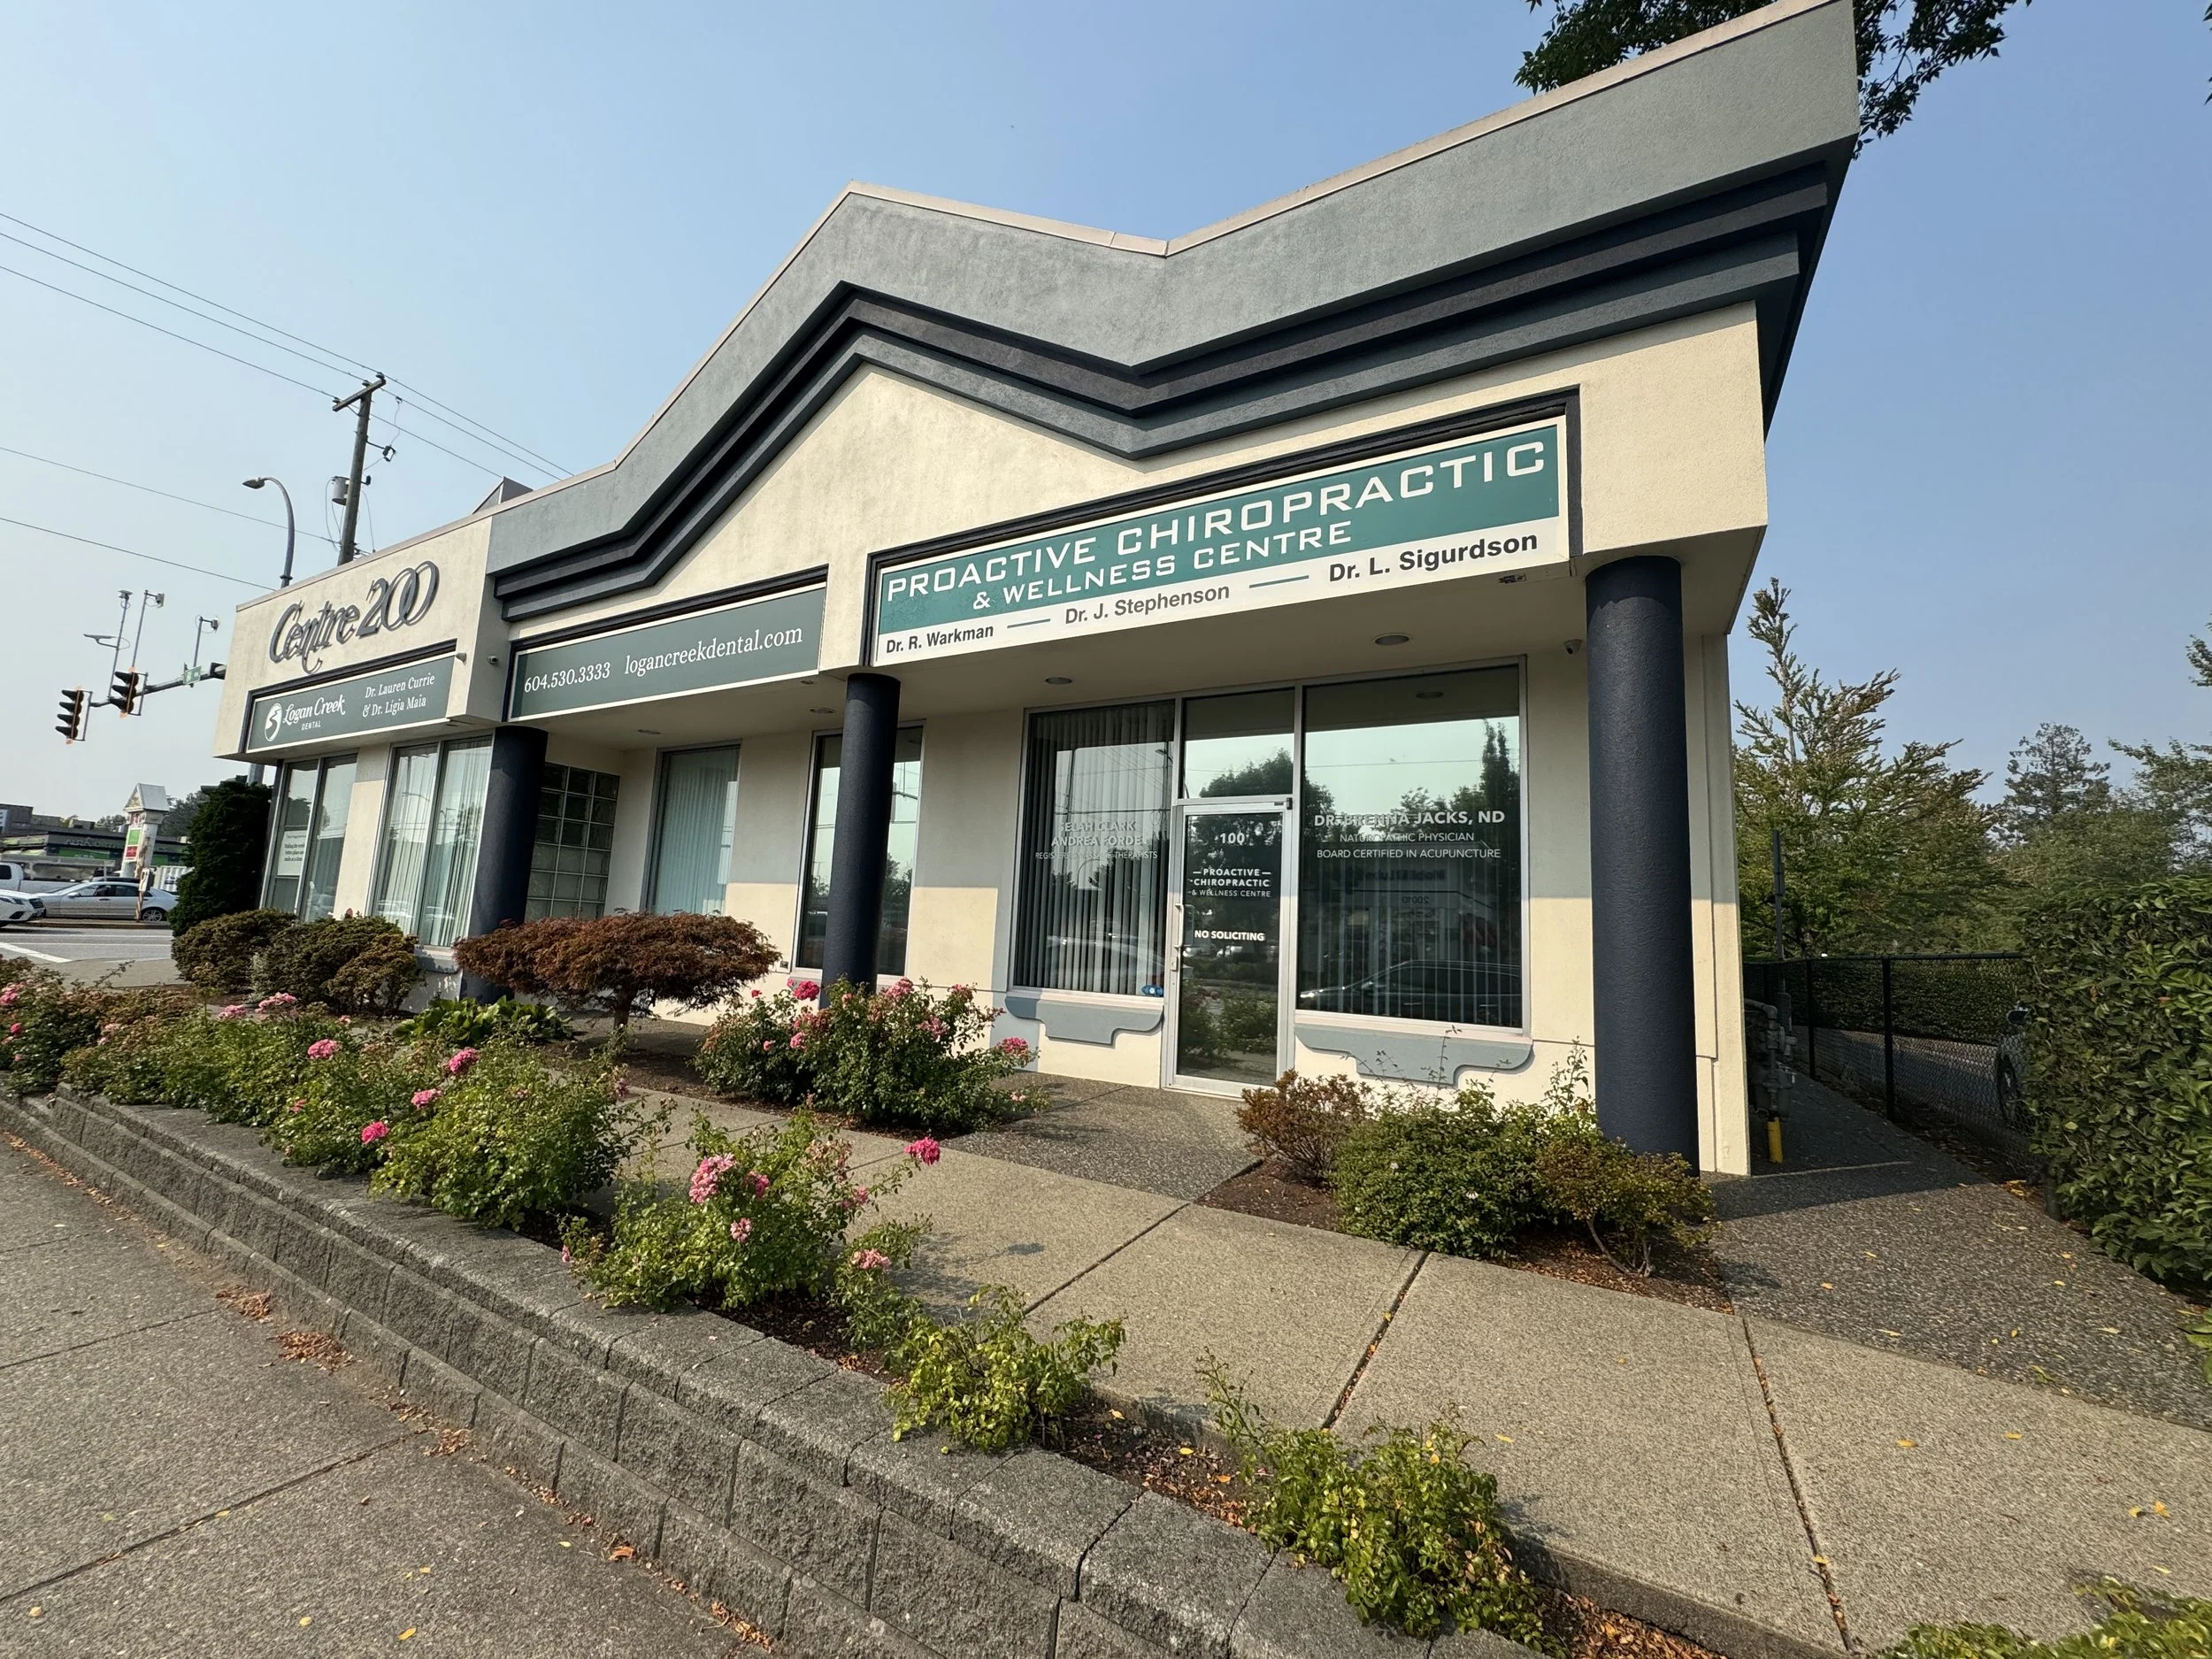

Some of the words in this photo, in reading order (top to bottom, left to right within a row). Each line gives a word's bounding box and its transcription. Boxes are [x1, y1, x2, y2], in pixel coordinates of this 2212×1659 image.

[887, 537, 1097, 602] PROACTIVE
[1118, 442, 1545, 556] CHIROPRACTIC
[973, 592, 991, 611] &
[1002, 554, 1176, 604] WELLNESS
[1194, 520, 1351, 570] CENTRE
[1329, 563, 1360, 582] Dr.
[1369, 557, 1392, 575] L.
[1399, 534, 1538, 572] Sigurdson
[270, 600, 358, 673] Centre
[357, 561, 439, 637] 200
[1065, 607, 1087, 625] Dr.
[1094, 603, 1109, 619] J.
[1114, 584, 1230, 616] Stephenson
[886, 637, 903, 654] Dr.
[908, 635, 922, 650] R.
[926, 625, 994, 647] Warkman
[524, 662, 611, 693] 604.530.3333
[625, 626, 803, 677] logancreekdental.com
[365, 687, 376, 698] Dr.
[378, 681, 406, 695] Lauren
[408, 672, 435, 689] Currie
[282, 703, 313, 726] Logan
[314, 695, 346, 716] Creek
[362, 704, 371, 718] &
[372, 703, 383, 717] Dr.
[407, 694, 426, 710] Maia
[301, 720, 321, 731] DENTAL
[1416, 811, 1473, 825] JACKS,
[1479, 810, 1505, 823] ND
[1051, 836, 1099, 847] ANDREA
[1220, 833, 1246, 844] 100
[1418, 833, 1474, 841] PHYSICIAN
[1317, 849, 1350, 858] BOARD
[1353, 849, 1403, 858] CERTIFIED
[1406, 849, 1417, 858] IN
[1420, 849, 1501, 858] ACUPUNCTURE
[1211, 931, 1265, 941] SOLICITING
